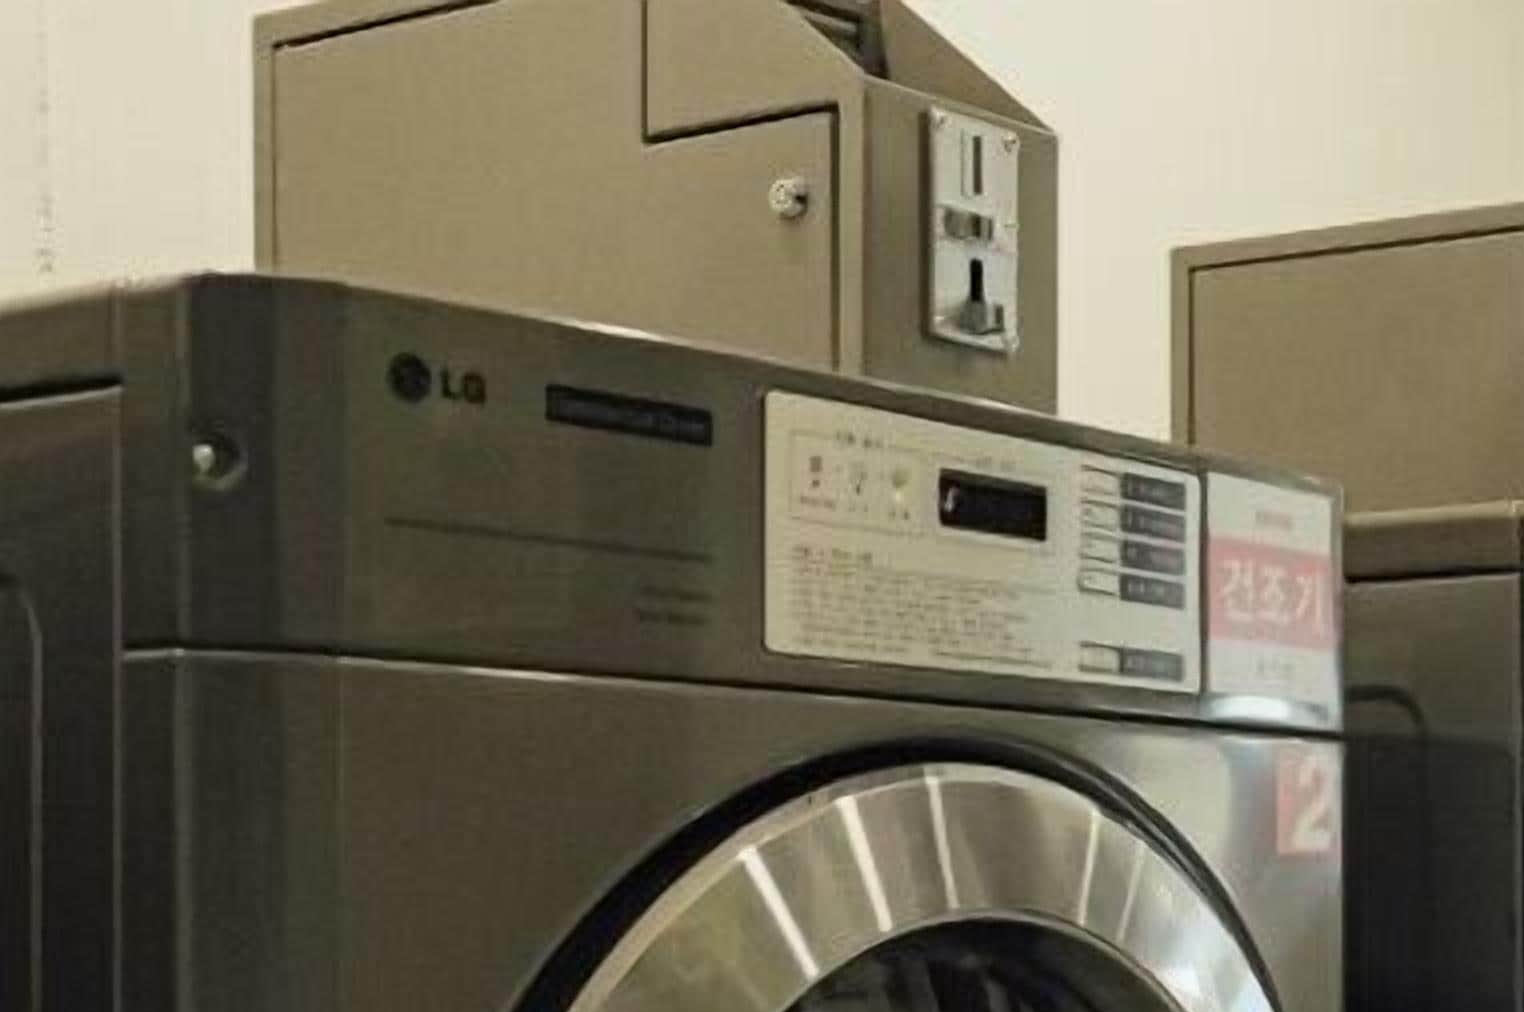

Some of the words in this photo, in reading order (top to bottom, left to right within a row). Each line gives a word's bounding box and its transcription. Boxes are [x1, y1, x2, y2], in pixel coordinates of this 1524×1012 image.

[441, 368, 486, 405] LG
[1218, 557, 1327, 638] 건조기
[1291, 752, 1331, 852] 2
